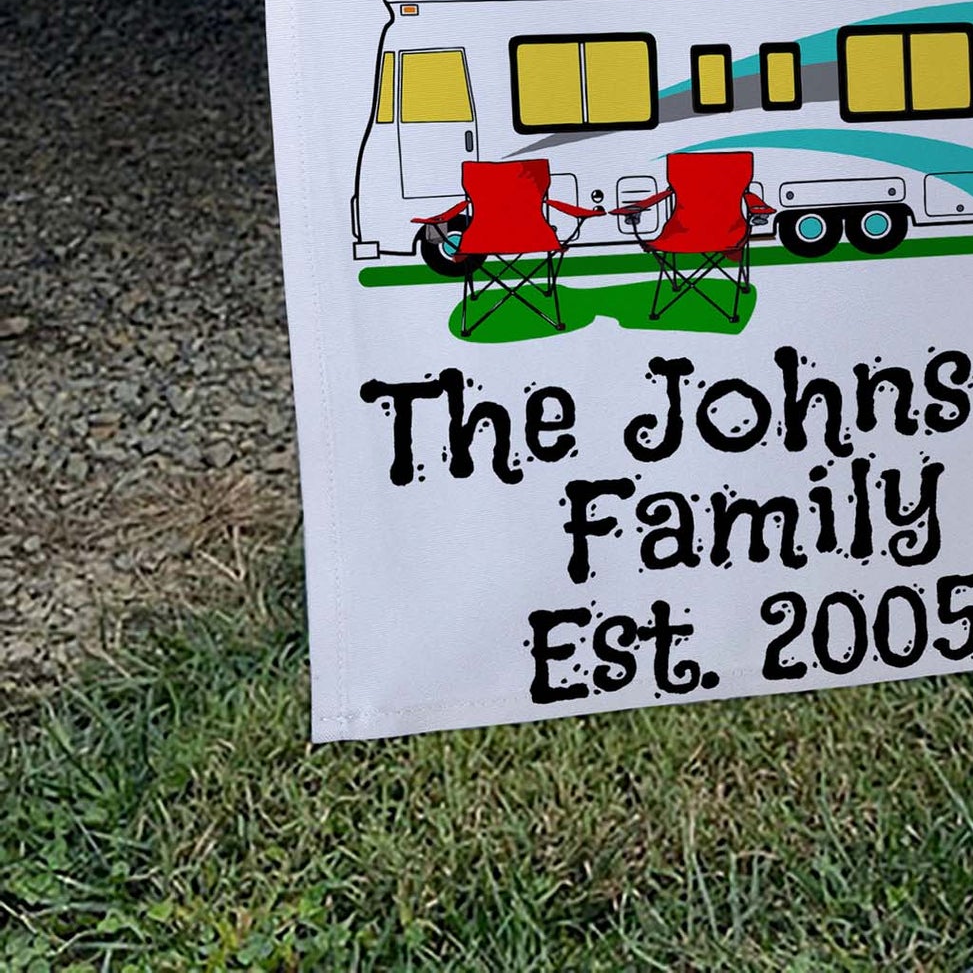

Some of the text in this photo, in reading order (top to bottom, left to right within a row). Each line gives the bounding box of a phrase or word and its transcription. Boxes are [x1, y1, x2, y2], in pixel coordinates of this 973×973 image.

[360, 368, 577, 486] The
[562, 458, 944, 584] Family
[527, 601, 720, 705] Est.
